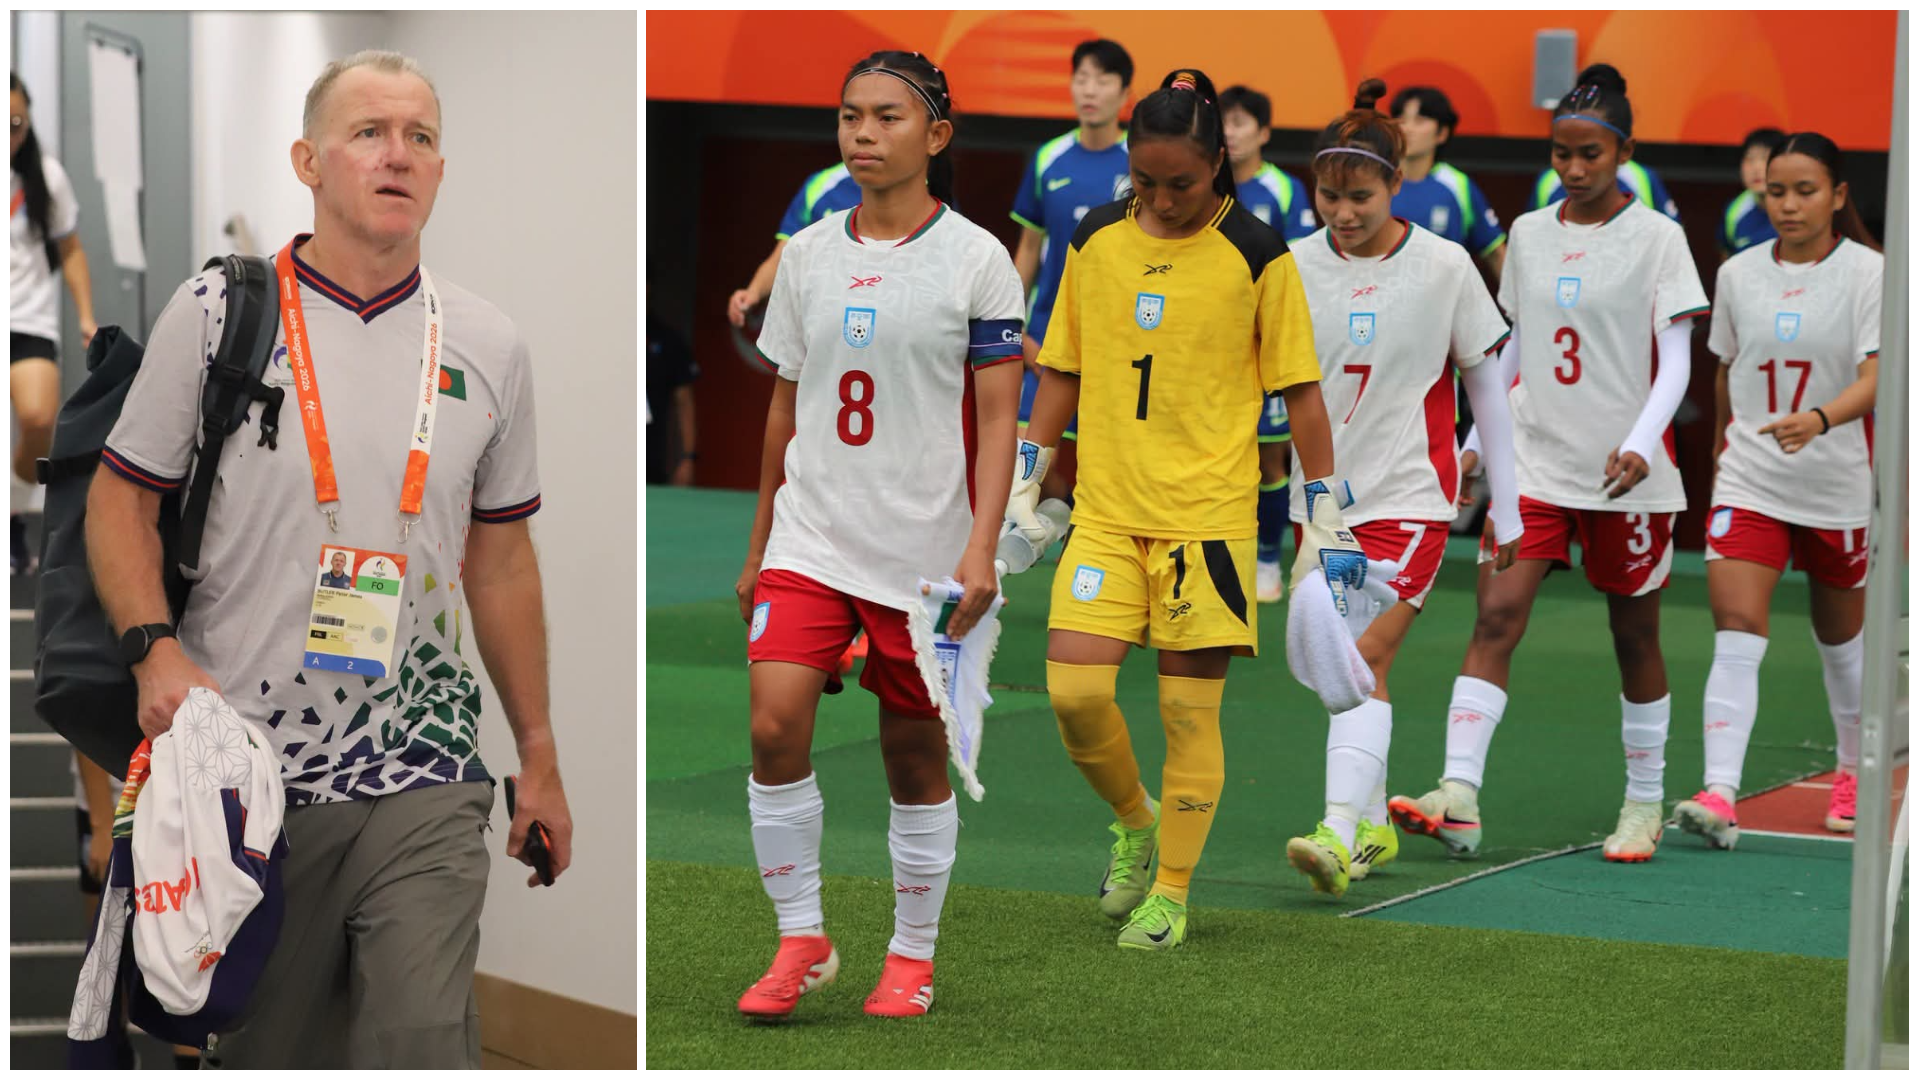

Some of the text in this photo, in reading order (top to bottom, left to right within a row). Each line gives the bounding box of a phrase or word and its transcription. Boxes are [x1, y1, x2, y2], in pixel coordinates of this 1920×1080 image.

[430, 323, 438, 344] 2026
[1553, 326, 1582, 385] 3
[299, 368, 311, 391] 2026
[1131, 354, 1153, 421] 1
[1343, 364, 1372, 424] 7
[1757, 358, 1813, 414] 17
[836, 369, 875, 447] 8
[1398, 521, 1427, 572] 7
[1625, 511, 1653, 555] 3
[371, 581, 384, 591] FO
[1168, 544, 1186, 600] 1
[312, 656, 354, 670] A 2
